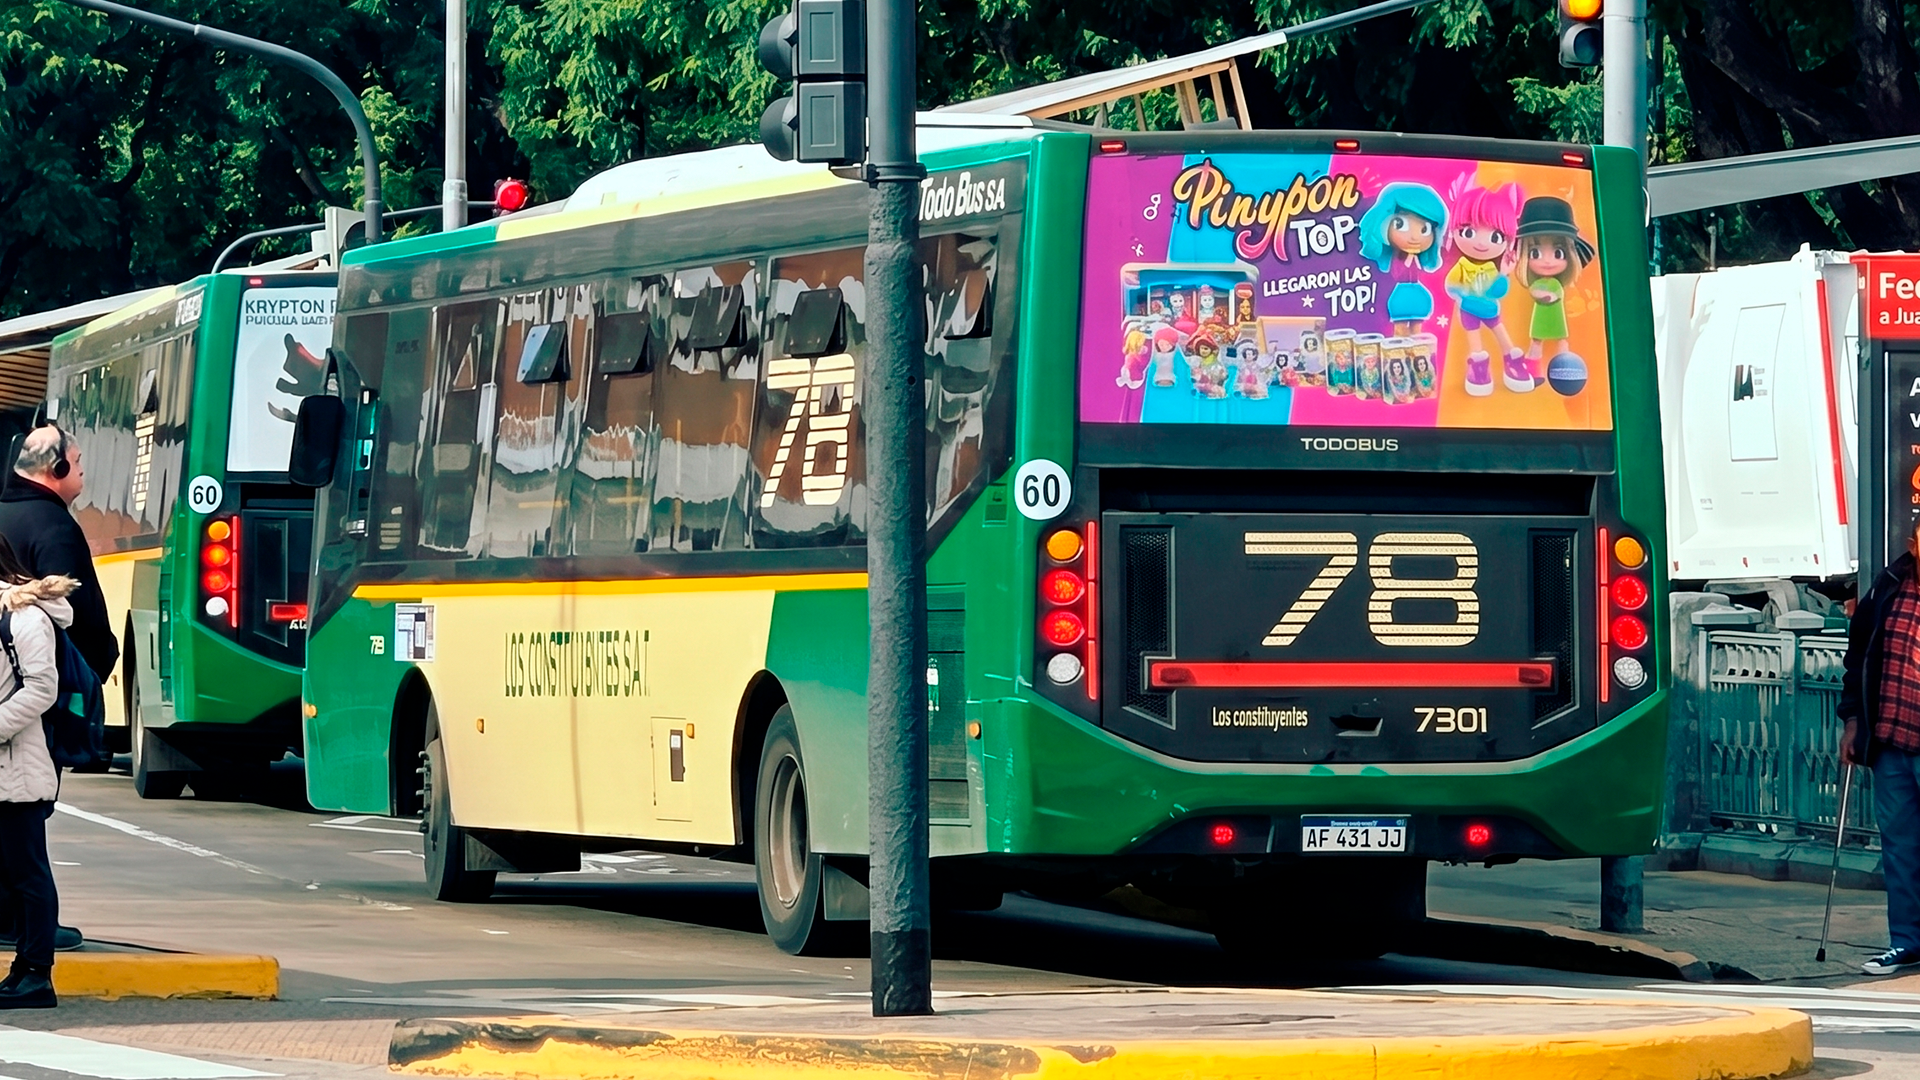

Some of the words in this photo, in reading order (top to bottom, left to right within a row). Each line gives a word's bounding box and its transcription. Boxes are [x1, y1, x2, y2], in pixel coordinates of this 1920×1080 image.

[919, 176, 955, 221] Todo
[954, 171, 985, 217] Bus
[985, 178, 1006, 212] SA
[1289, 215, 1356, 257] TOP
[1263, 270, 1340, 298] LLEGARON
[1344, 265, 1372, 284] LAS
[1879, 272, 1920, 300] Fe
[245, 299, 325, 314] KRYPTON
[1324, 281, 1378, 318] TOP!
[1879, 311, 1890, 325] a
[760, 353, 856, 509] 78
[1300, 438, 1399, 451] TODOBUS
[193, 485, 217, 505] 60
[1023, 473, 1060, 508] 60
[1244, 532, 1480, 647] 78
[505, 632, 524, 697] LOS
[1212, 706, 1231, 727] Los
[1233, 706, 1308, 732] constituyentes
[1413, 707, 1488, 733] 7301
[1306, 828, 1330, 848] AF
[1336, 828, 1371, 848] 431
[1377, 828, 1402, 848] JJ
